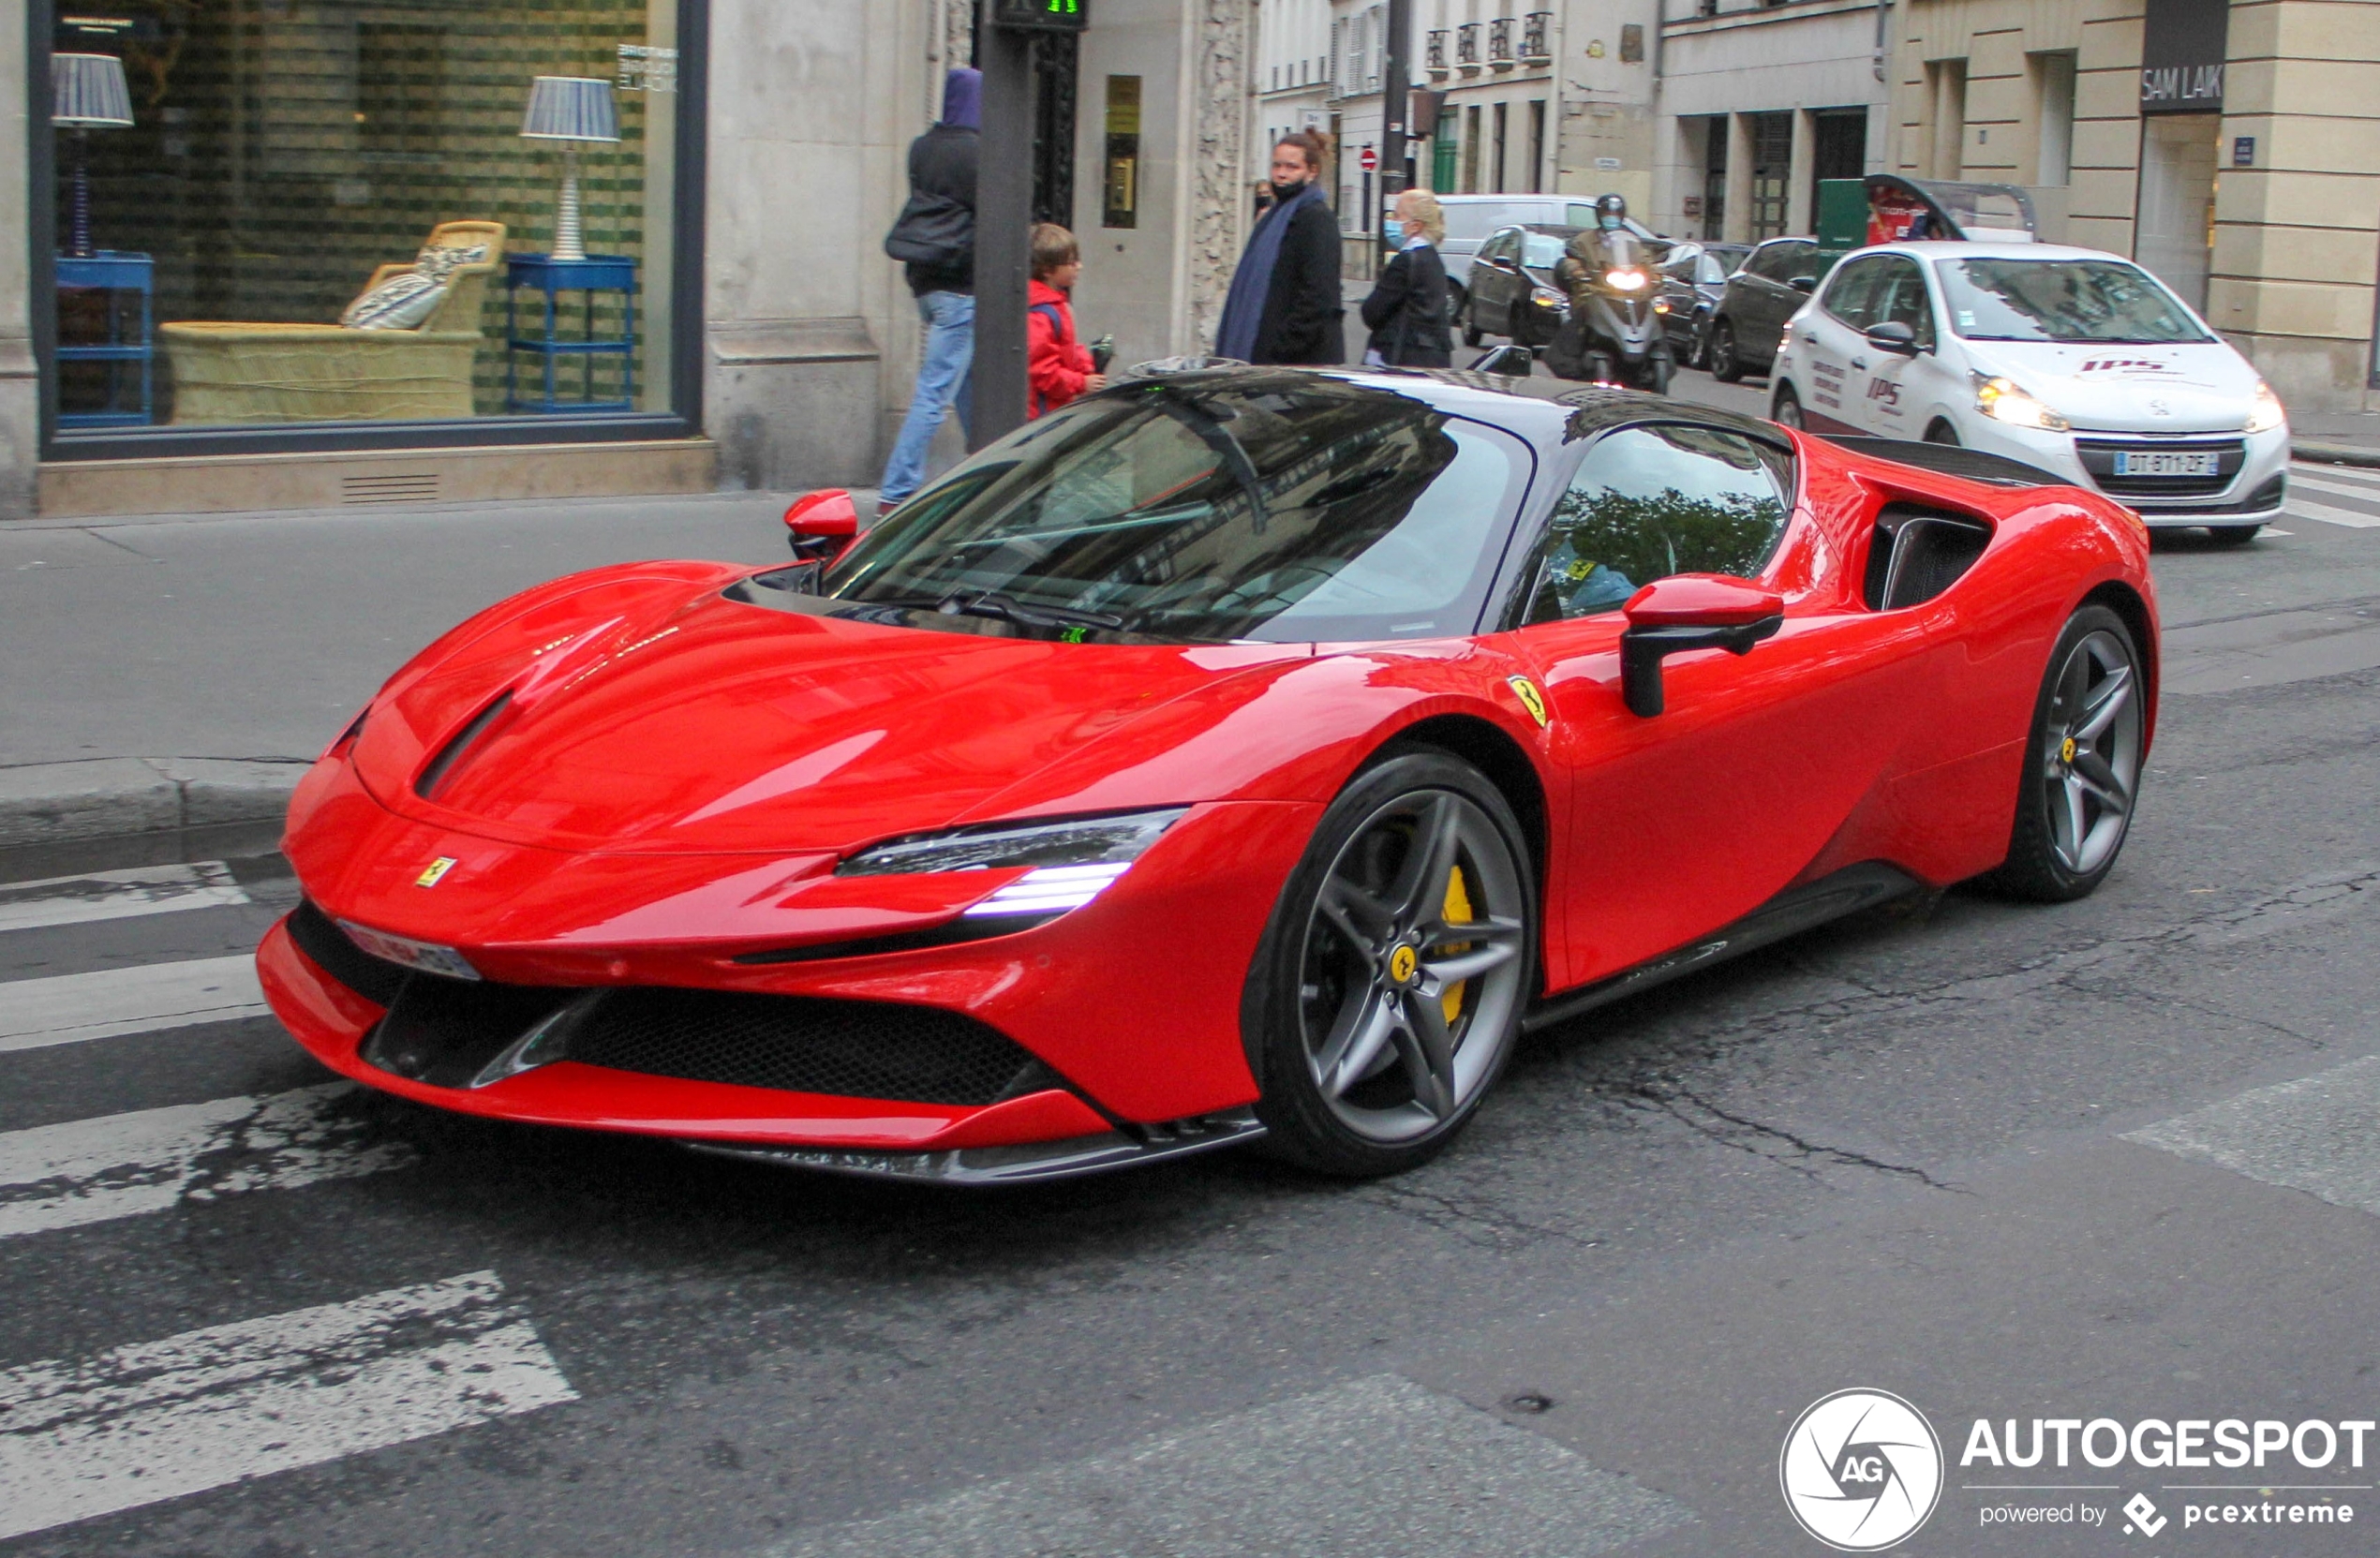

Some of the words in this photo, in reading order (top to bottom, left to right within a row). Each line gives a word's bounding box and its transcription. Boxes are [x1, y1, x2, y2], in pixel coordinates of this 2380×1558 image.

[2140, 67, 2179, 100] SAM
[2081, 360, 2167, 371] IPS
[1867, 377, 1903, 405] IPS
